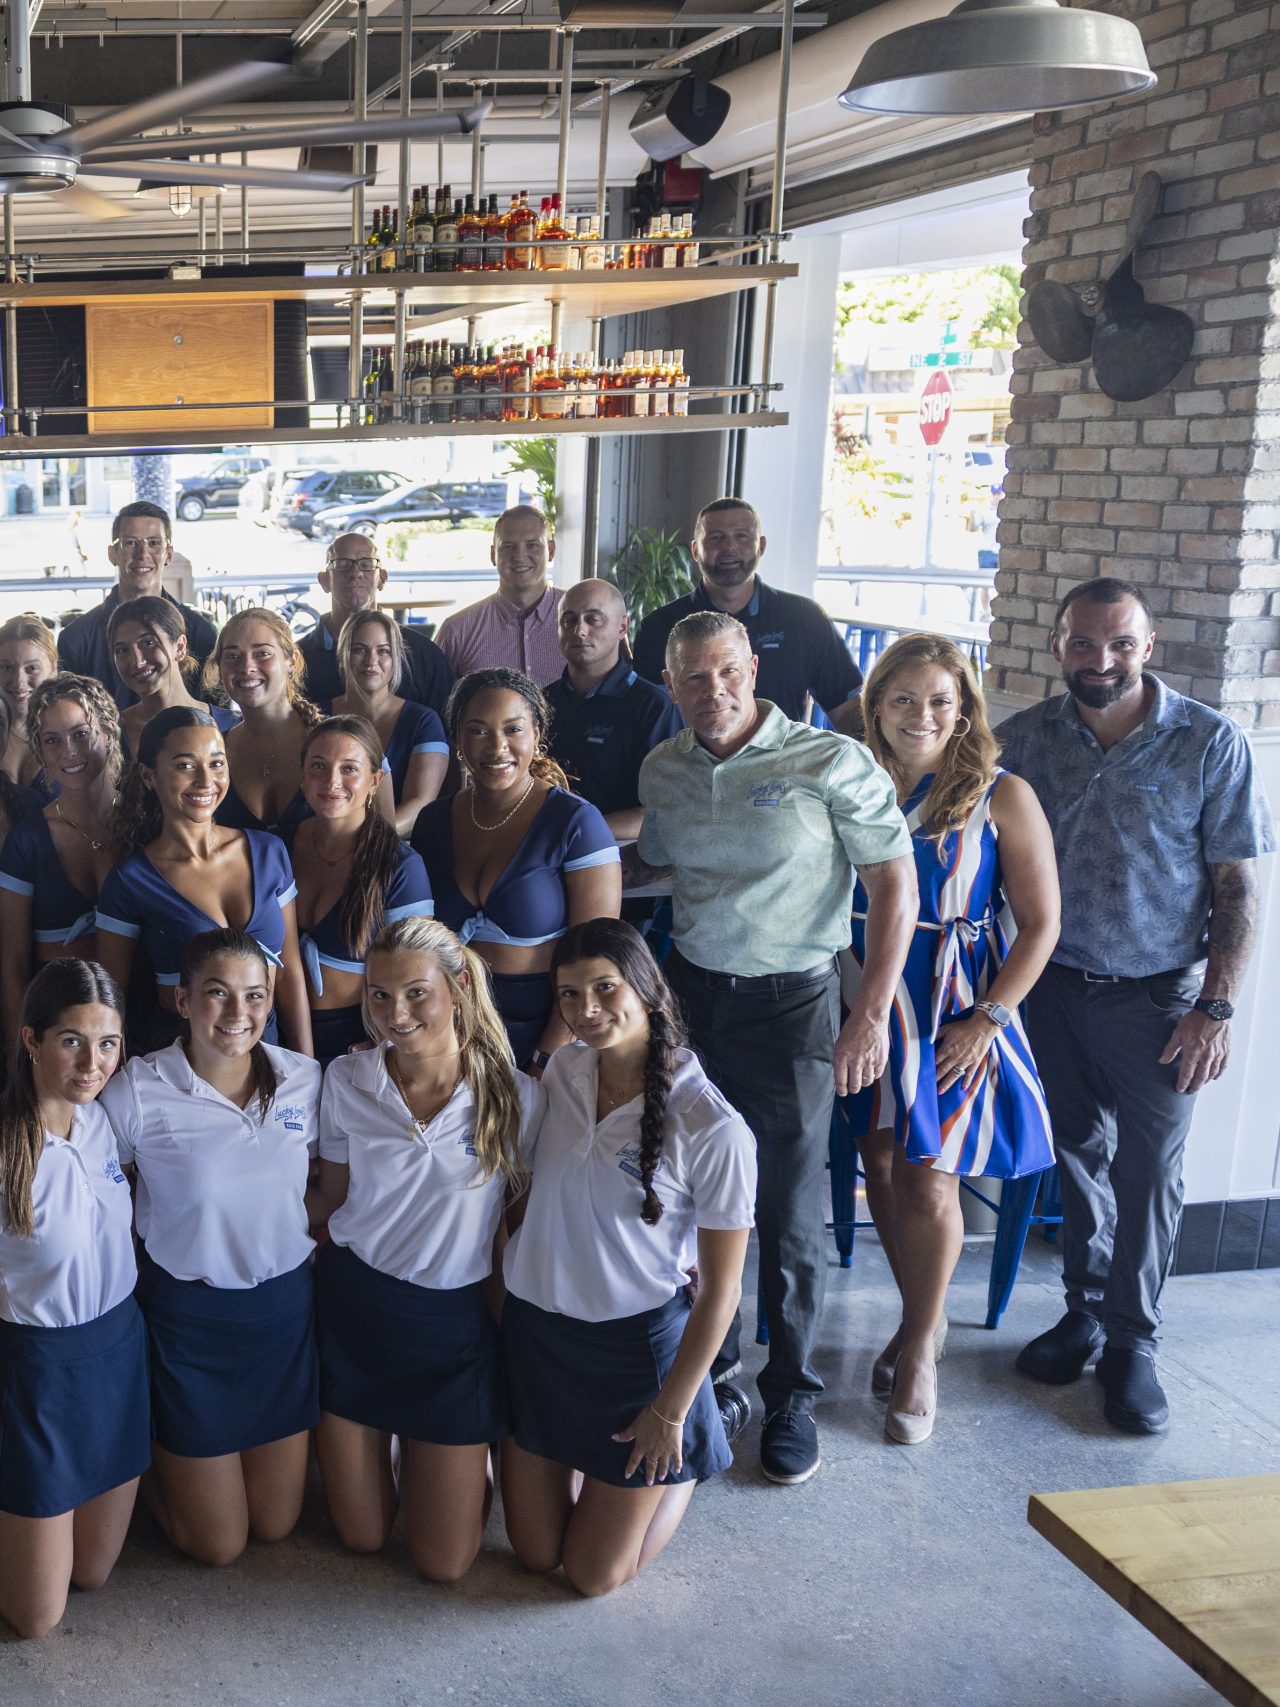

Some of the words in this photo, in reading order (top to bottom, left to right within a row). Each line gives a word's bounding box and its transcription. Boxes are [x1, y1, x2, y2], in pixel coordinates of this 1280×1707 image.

[911, 354, 928, 367] NE
[938, 352, 947, 366] 2
[959, 353, 972, 365] ST
[920, 391, 951, 424] STOP
[275, 1104, 295, 1121] Lucky
